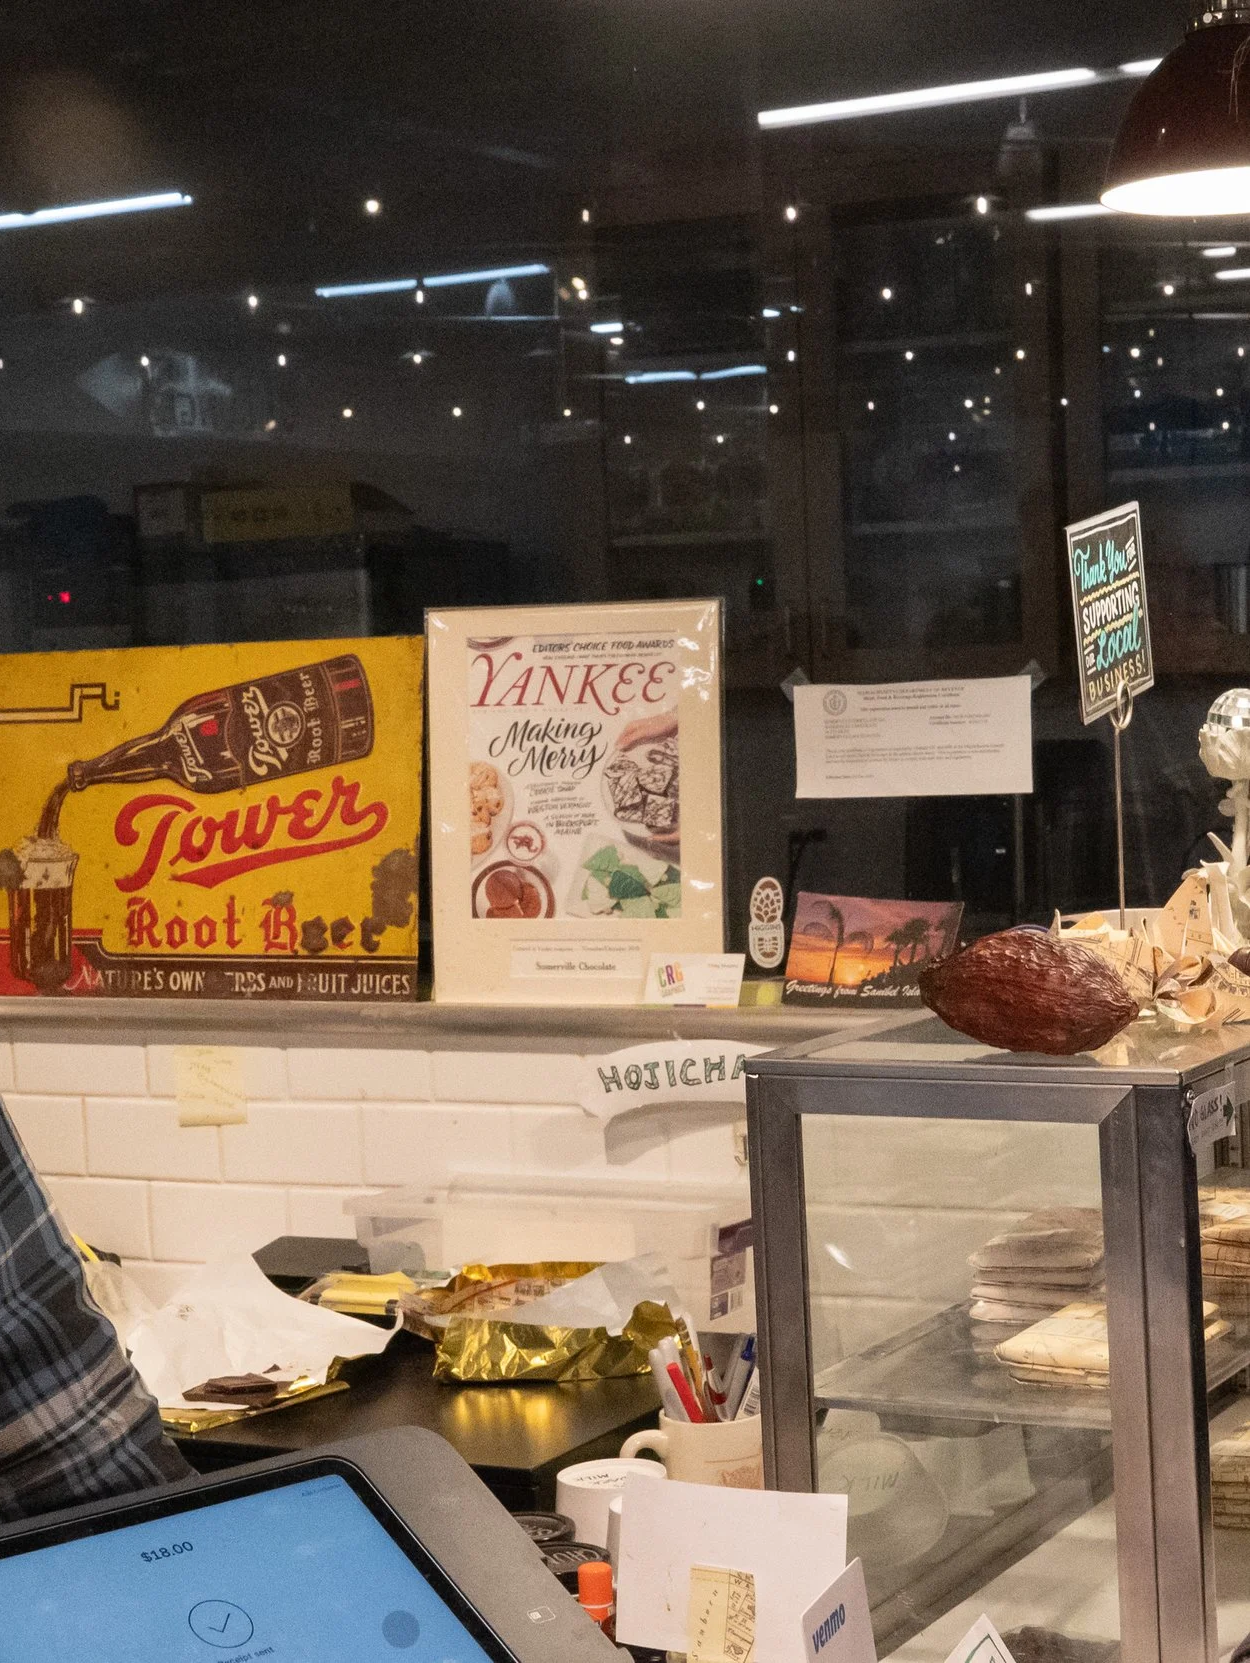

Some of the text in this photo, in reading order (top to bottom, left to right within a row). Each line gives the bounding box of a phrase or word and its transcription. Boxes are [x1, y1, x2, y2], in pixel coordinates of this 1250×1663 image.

[1072, 544, 1107, 592] Thank
[1106, 539, 1128, 583] You
[1082, 581, 1140, 635] SUPPORTING
[573, 641, 608, 651] CHOICE
[610, 639, 635, 650] FOOD
[635, 639, 675, 649] AWARDS
[1096, 603, 1141, 671] Local
[470, 652, 676, 716] YANKEE
[1088, 649, 1147, 701] BUSINESS!
[242, 686, 287, 777] Tower
[300, 672, 323, 765] Root Beer
[488, 717, 602, 757] Making
[507, 742, 608, 780] Merry
[114, 775, 389, 893] Tower
[126, 894, 243, 949] Root
[169, 971, 206, 991] OWN
[269, 976, 294, 989] AND
[352, 973, 411, 994] JUICES
[536, 961, 616, 972] Somerville Chocolate
[785, 980, 832, 997] Greetings
[833, 985, 857, 999] from
[860, 985, 900, 997] Sanibel
[140, 1541, 194, 1563] $18.00
[253, 1646, 275, 1658] sent
[812, 1603, 846, 1654] venmo
